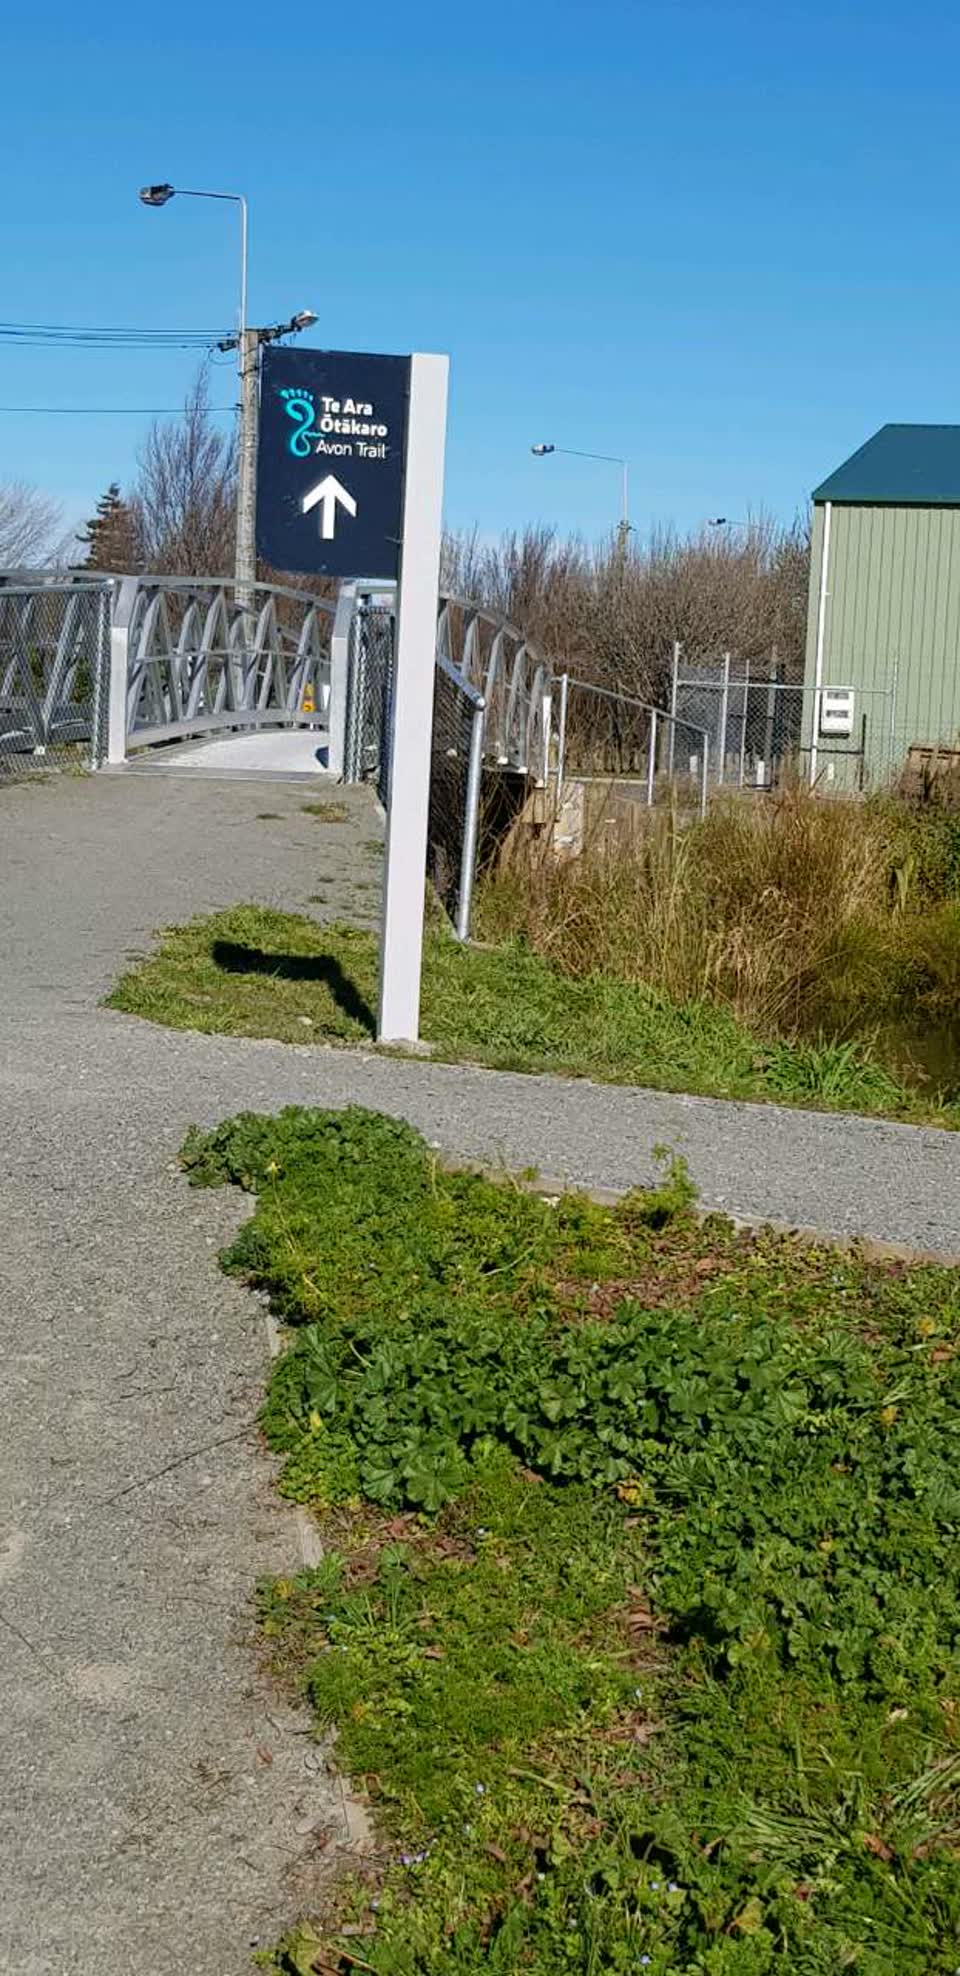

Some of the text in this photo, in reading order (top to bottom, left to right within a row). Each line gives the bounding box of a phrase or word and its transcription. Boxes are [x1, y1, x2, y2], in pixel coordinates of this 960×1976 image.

[321, 397, 373, 416] Te Ara
[320, 414, 388, 437] Ōtākaro
[315, 439, 386, 459] Avon Trail
